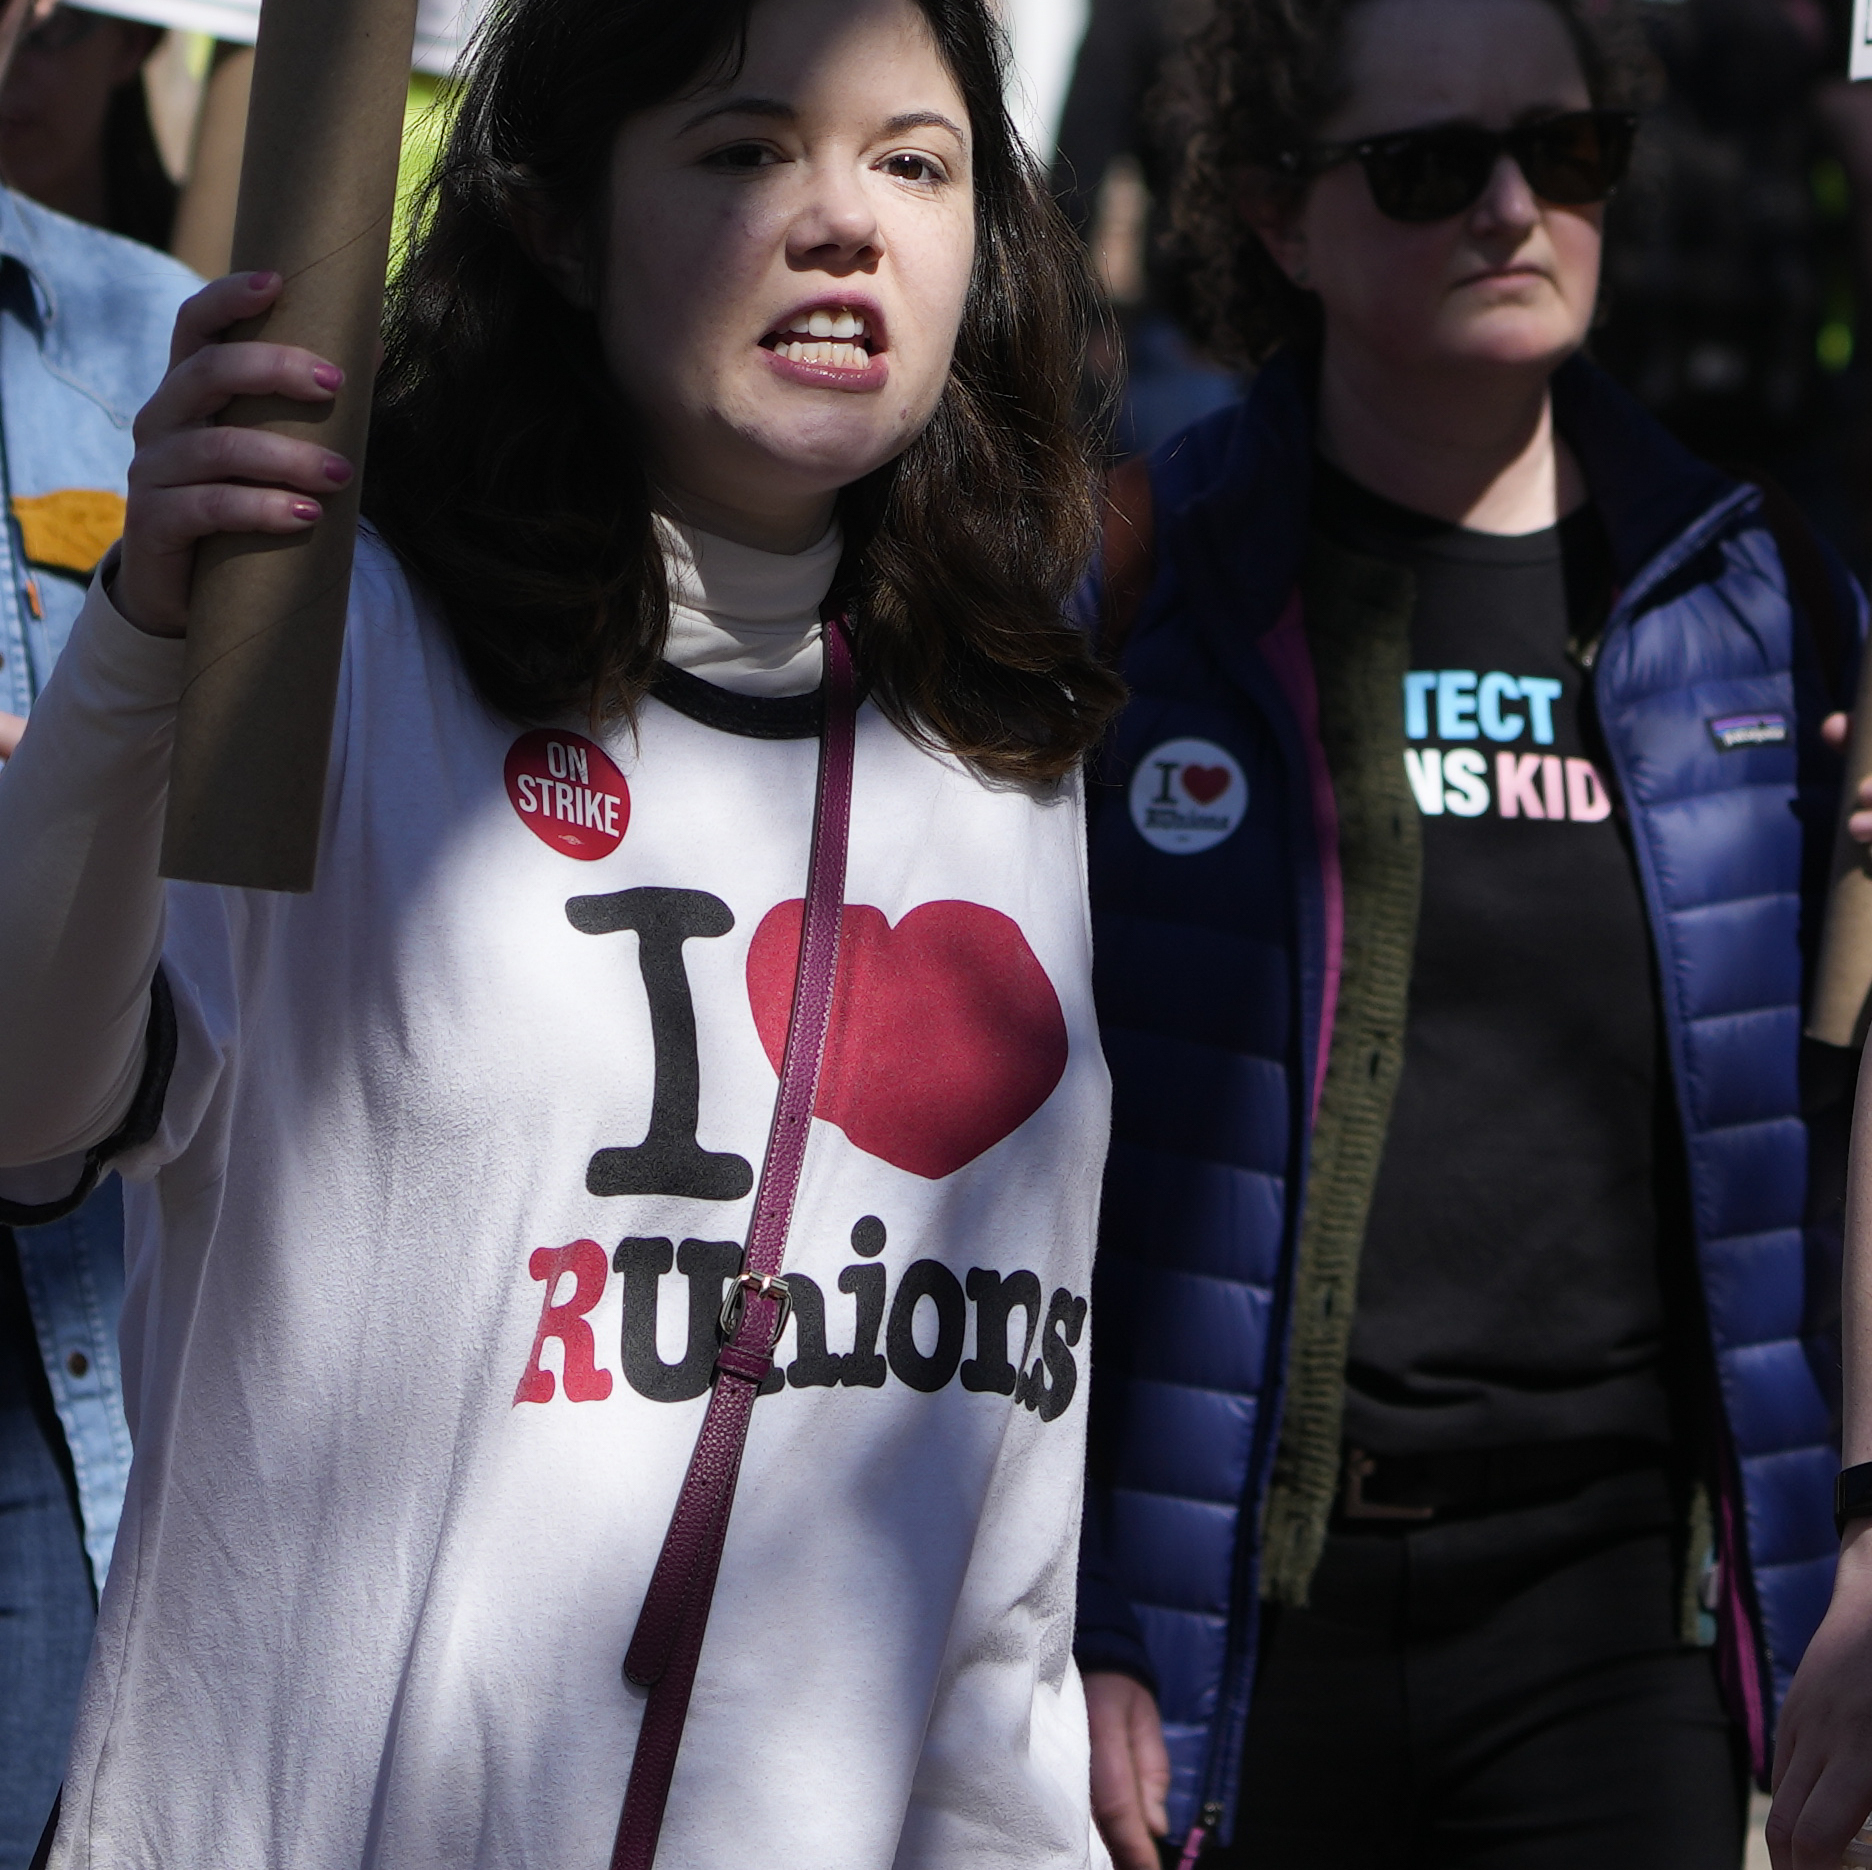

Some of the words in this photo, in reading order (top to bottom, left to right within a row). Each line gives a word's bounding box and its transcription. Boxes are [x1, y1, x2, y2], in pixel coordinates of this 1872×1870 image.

[546, 741, 589, 785] ON
[1152, 761, 1180, 805] I
[517, 774, 621, 838] STRIKE
[564, 886, 754, 1202] I
